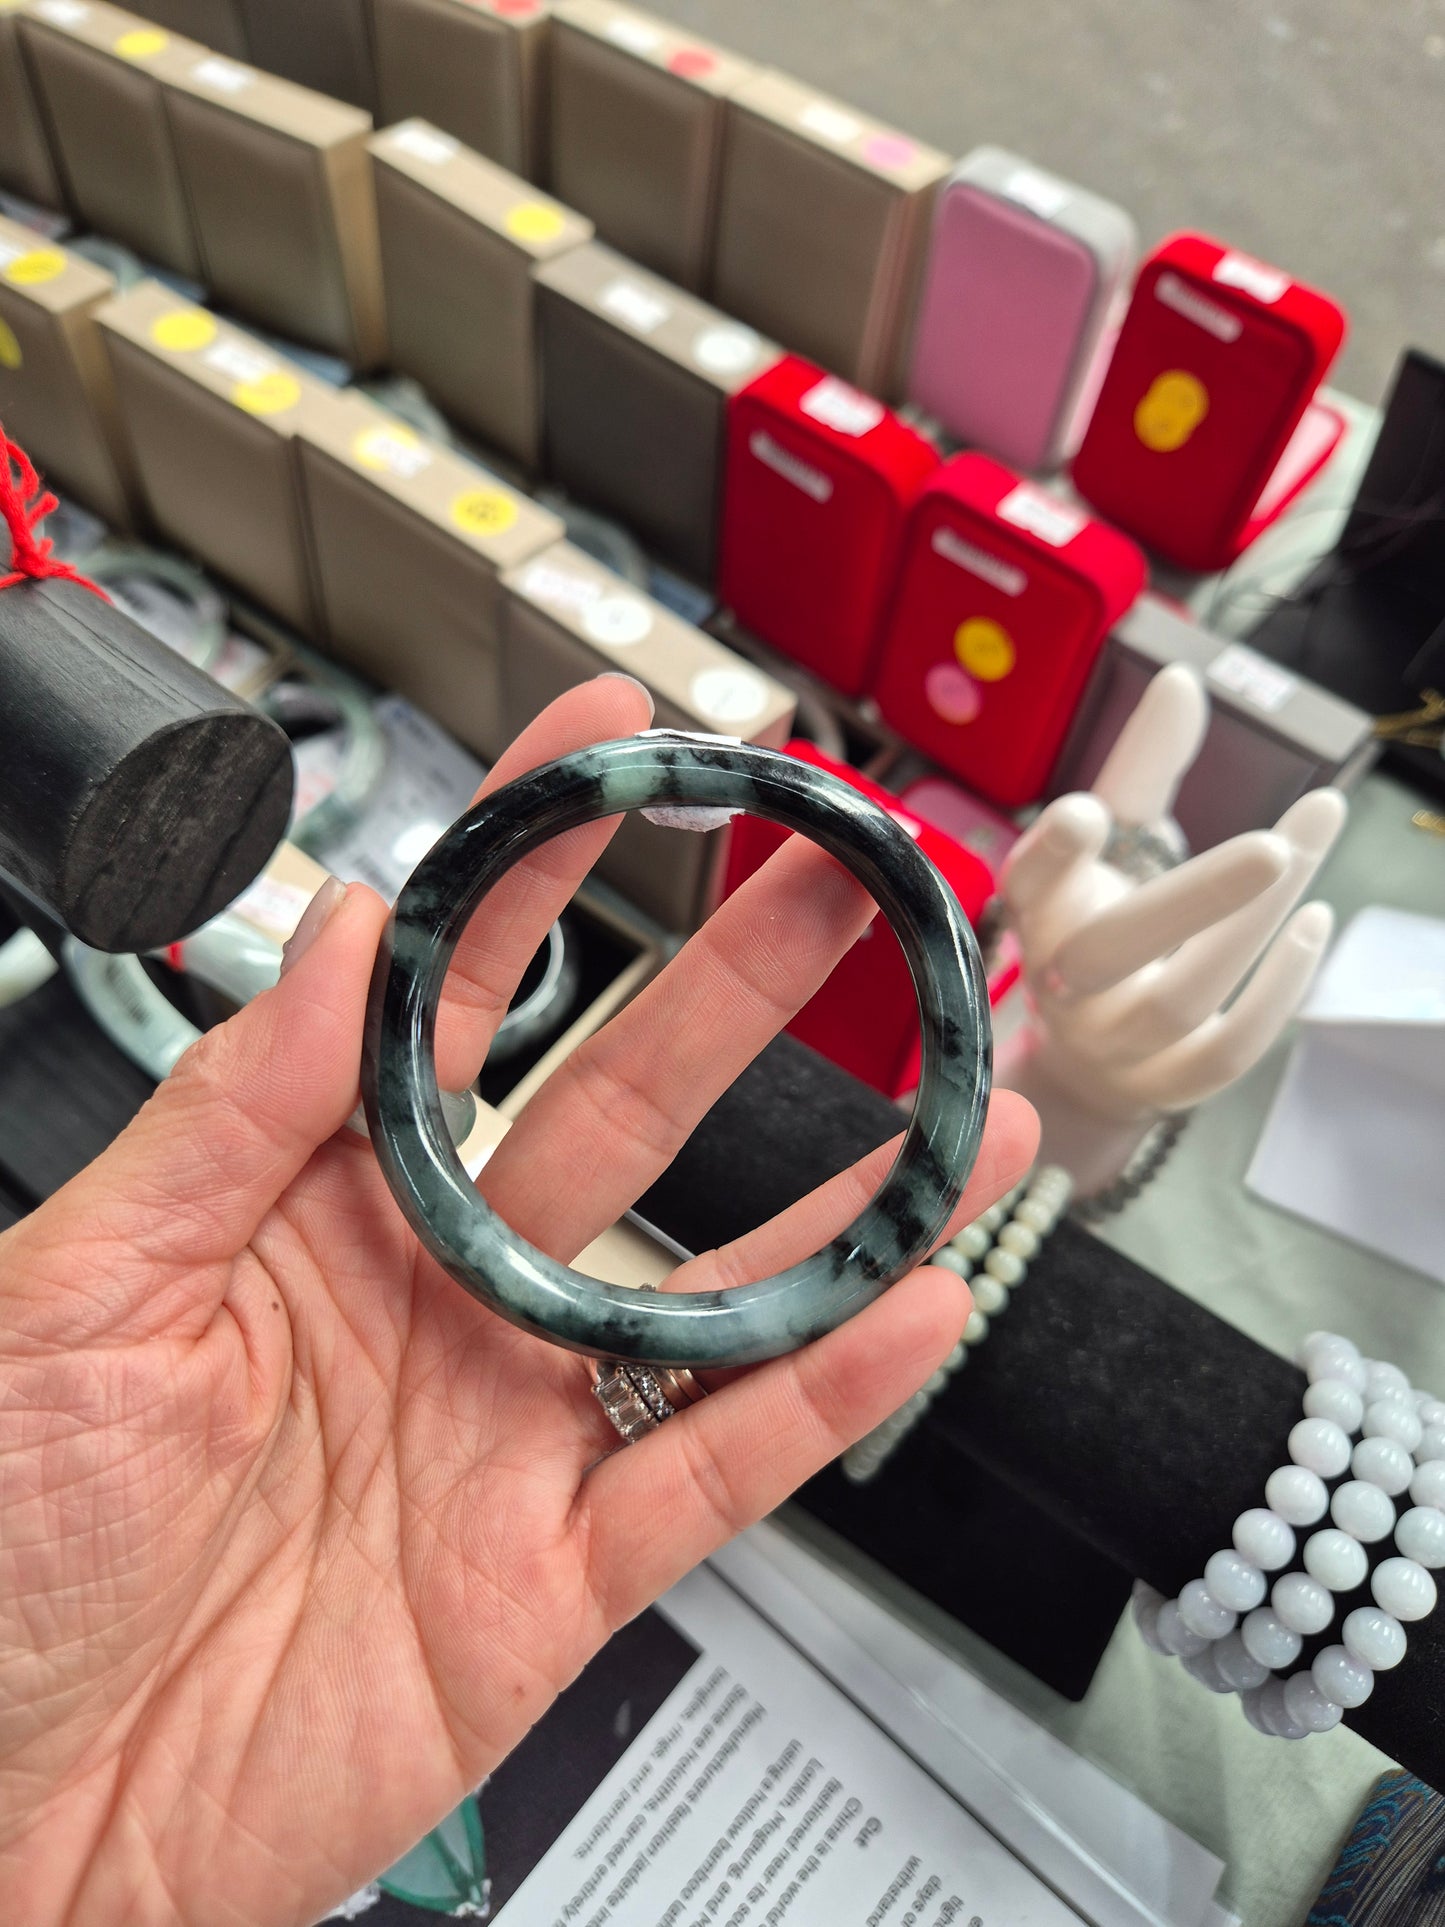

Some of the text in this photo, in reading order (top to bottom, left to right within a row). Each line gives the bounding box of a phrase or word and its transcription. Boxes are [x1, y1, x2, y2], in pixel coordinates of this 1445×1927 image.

[711, 1683, 748, 1725] Some
[686, 1703, 766, 1803] Manufacturers
[693, 1724, 714, 1750] are
[629, 1762, 653, 1793] and
[766, 1739, 802, 1781] using
[646, 1802, 692, 1857] fashion
[726, 1789, 768, 1840] hollow
[786, 1778, 843, 1851] fashioned
[824, 1797, 862, 1842] China
[854, 1816, 883, 1849] Cut
[605, 1814, 646, 1867] carved
[606, 1852, 651, 1907] jadeite
[680, 1837, 732, 1901] bamboo
[763, 1848, 790, 1885] near
[795, 1855, 821, 1883] the
[561, 1864, 608, 1920] entirely
[705, 1881, 731, 1915] and
[746, 1882, 768, 1904] its
[911, 1875, 942, 1913] days
